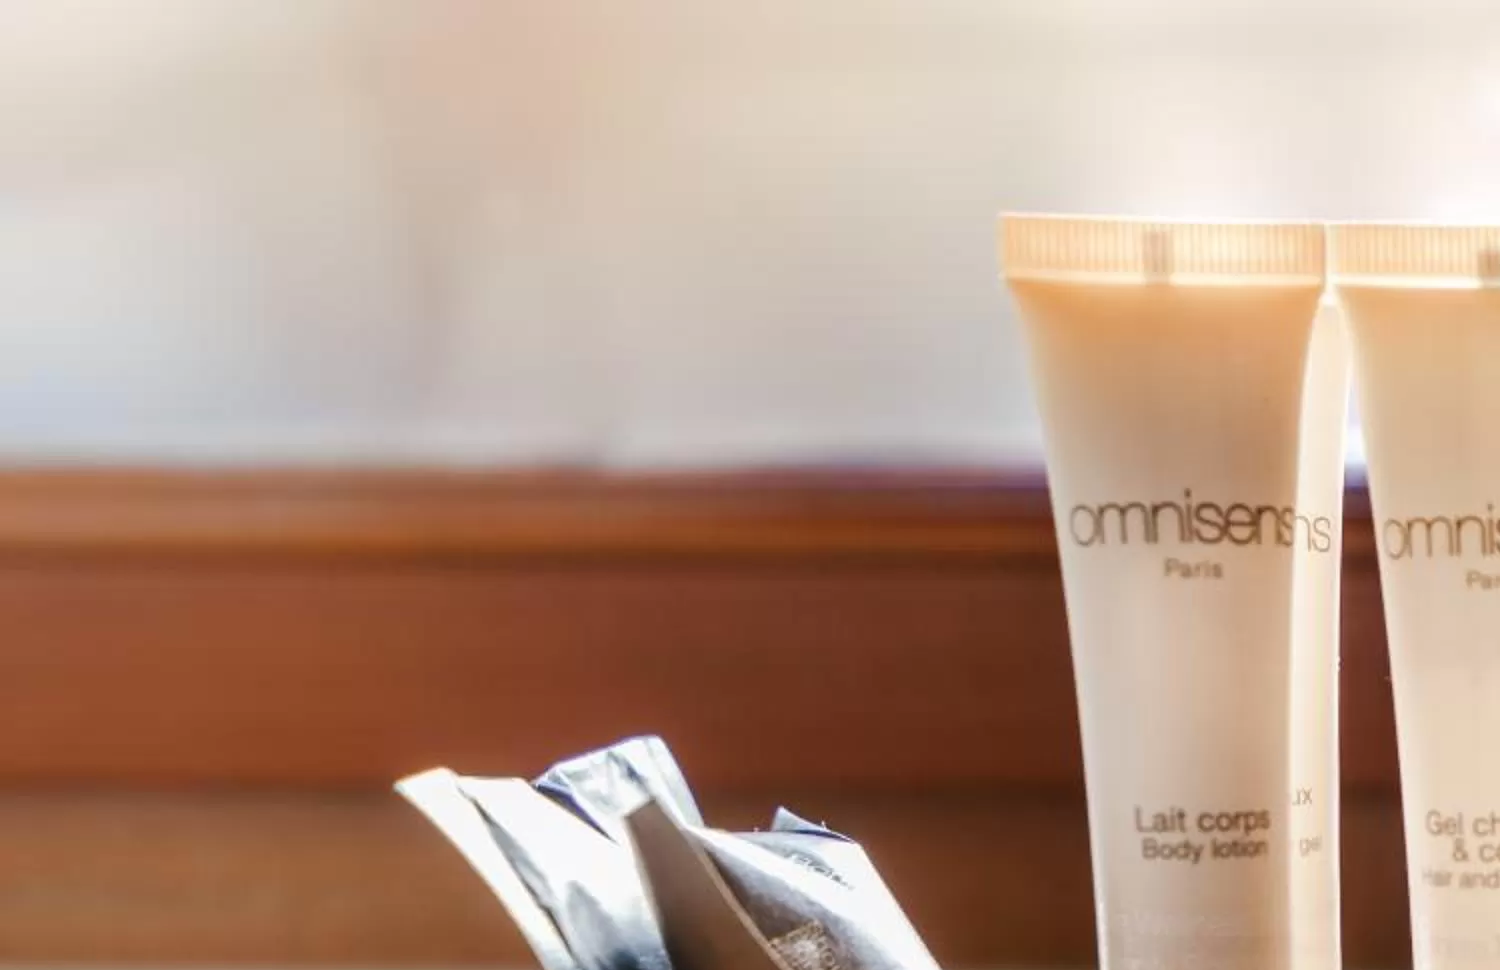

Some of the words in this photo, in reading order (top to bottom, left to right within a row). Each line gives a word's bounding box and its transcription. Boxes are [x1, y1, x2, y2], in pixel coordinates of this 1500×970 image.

[1070, 487, 1296, 547] omnisens
[1164, 557, 1225, 580] Paris
[1133, 805, 1187, 834] Lait
[1197, 808, 1272, 836] corps
[1424, 809, 1466, 837] Gel
[1141, 837, 1205, 865] Body
[1211, 837, 1269, 860] lotion
[1452, 838, 1470, 863] &
[1458, 869, 1500, 890] and
